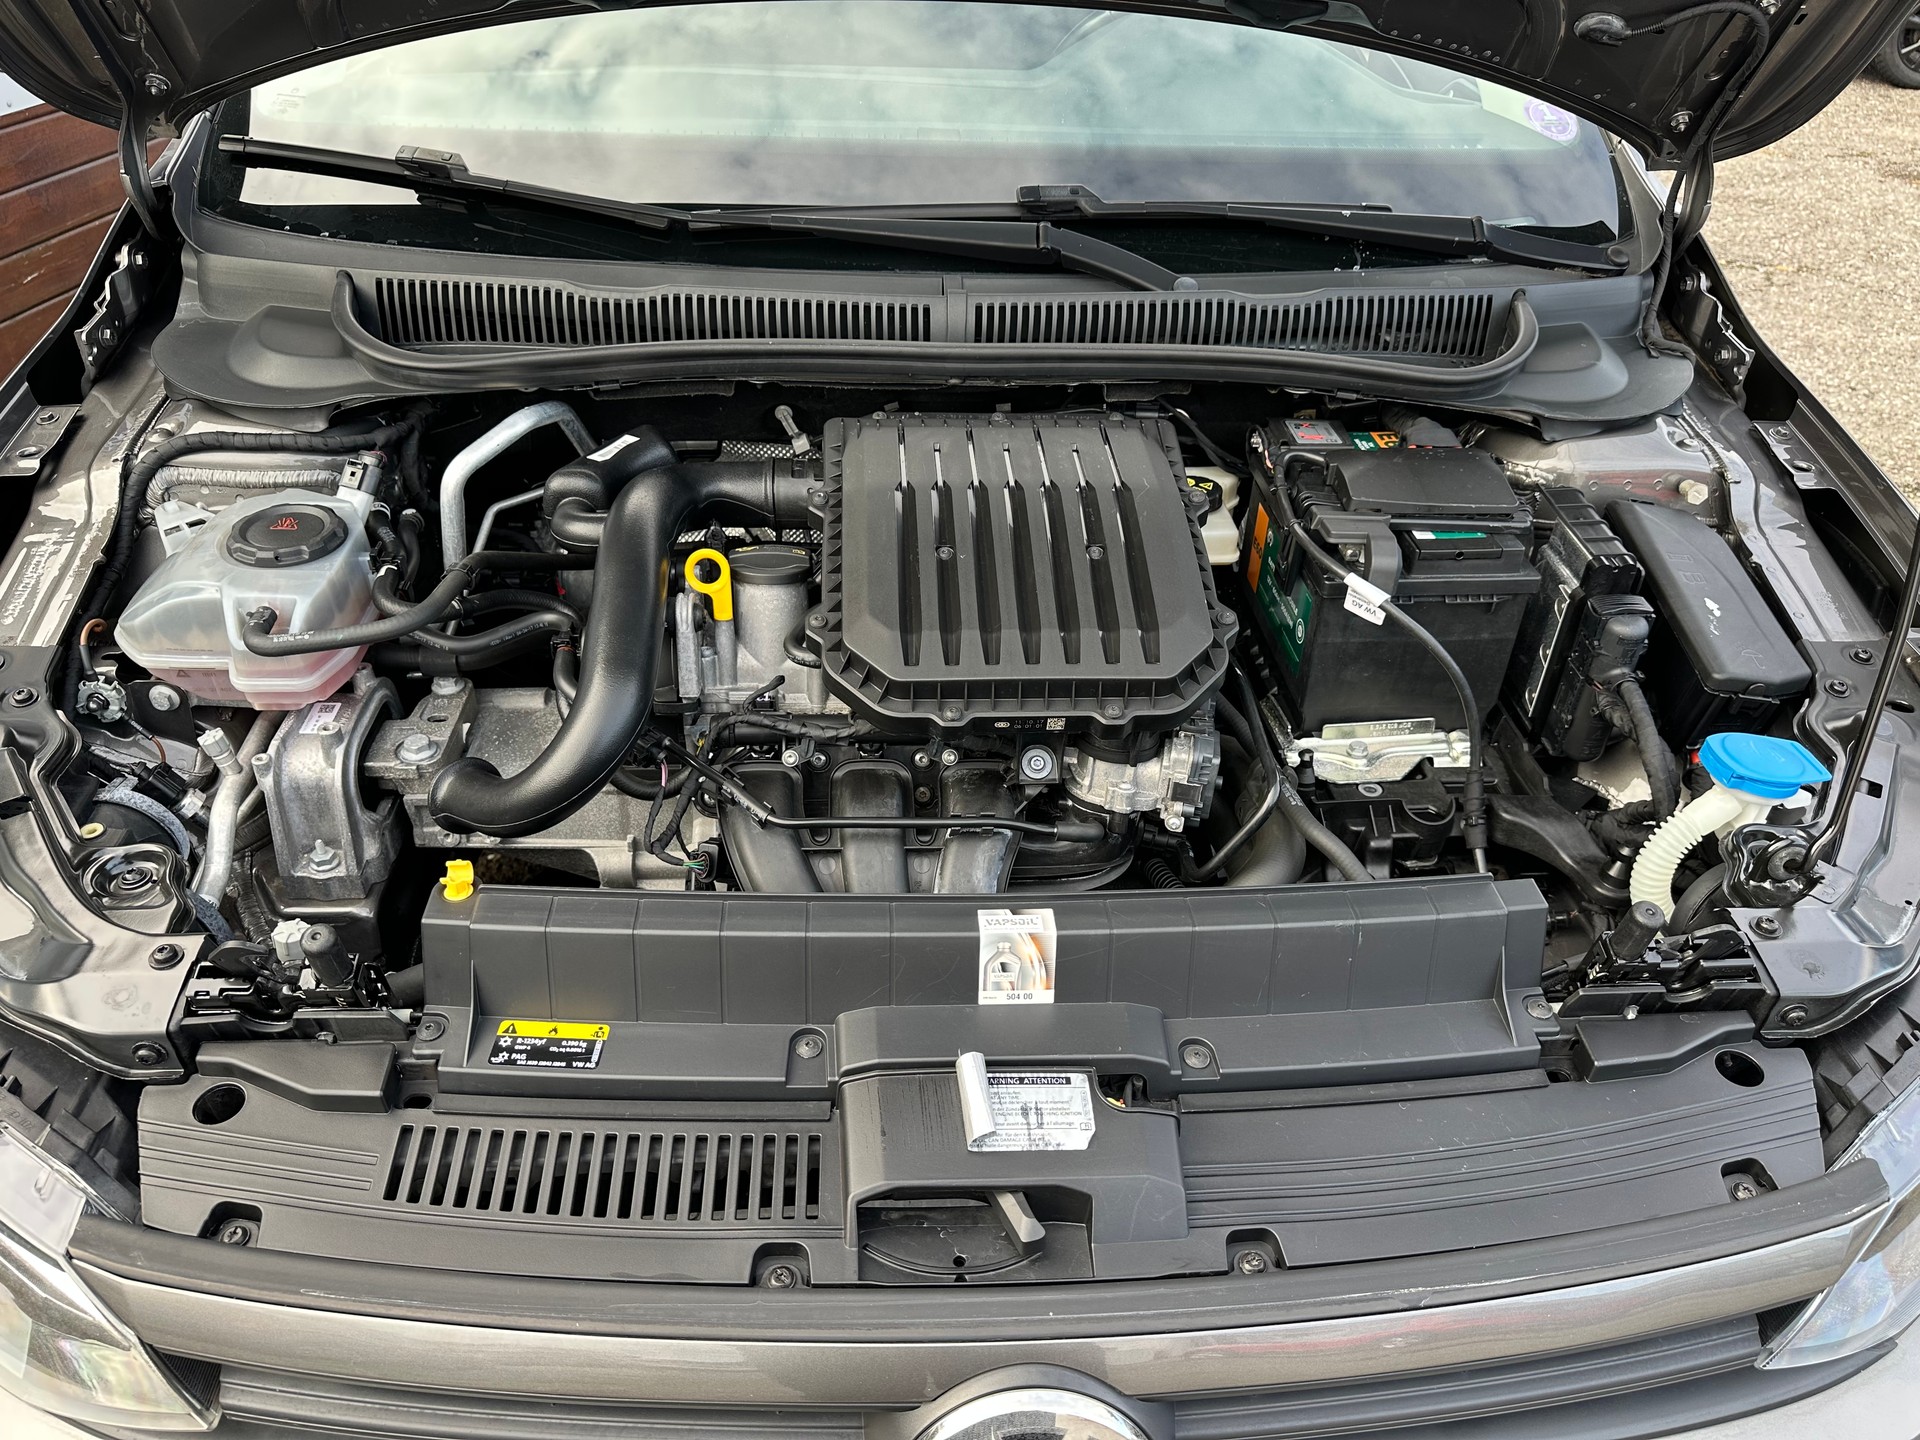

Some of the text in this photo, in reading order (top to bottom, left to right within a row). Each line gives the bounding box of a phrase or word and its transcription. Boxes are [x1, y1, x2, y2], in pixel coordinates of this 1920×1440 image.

[1538, 104, 1557, 120] 1
[1352, 599, 1377, 617] VW AG
[988, 1077, 1066, 1085] ARNING ATTENTION
